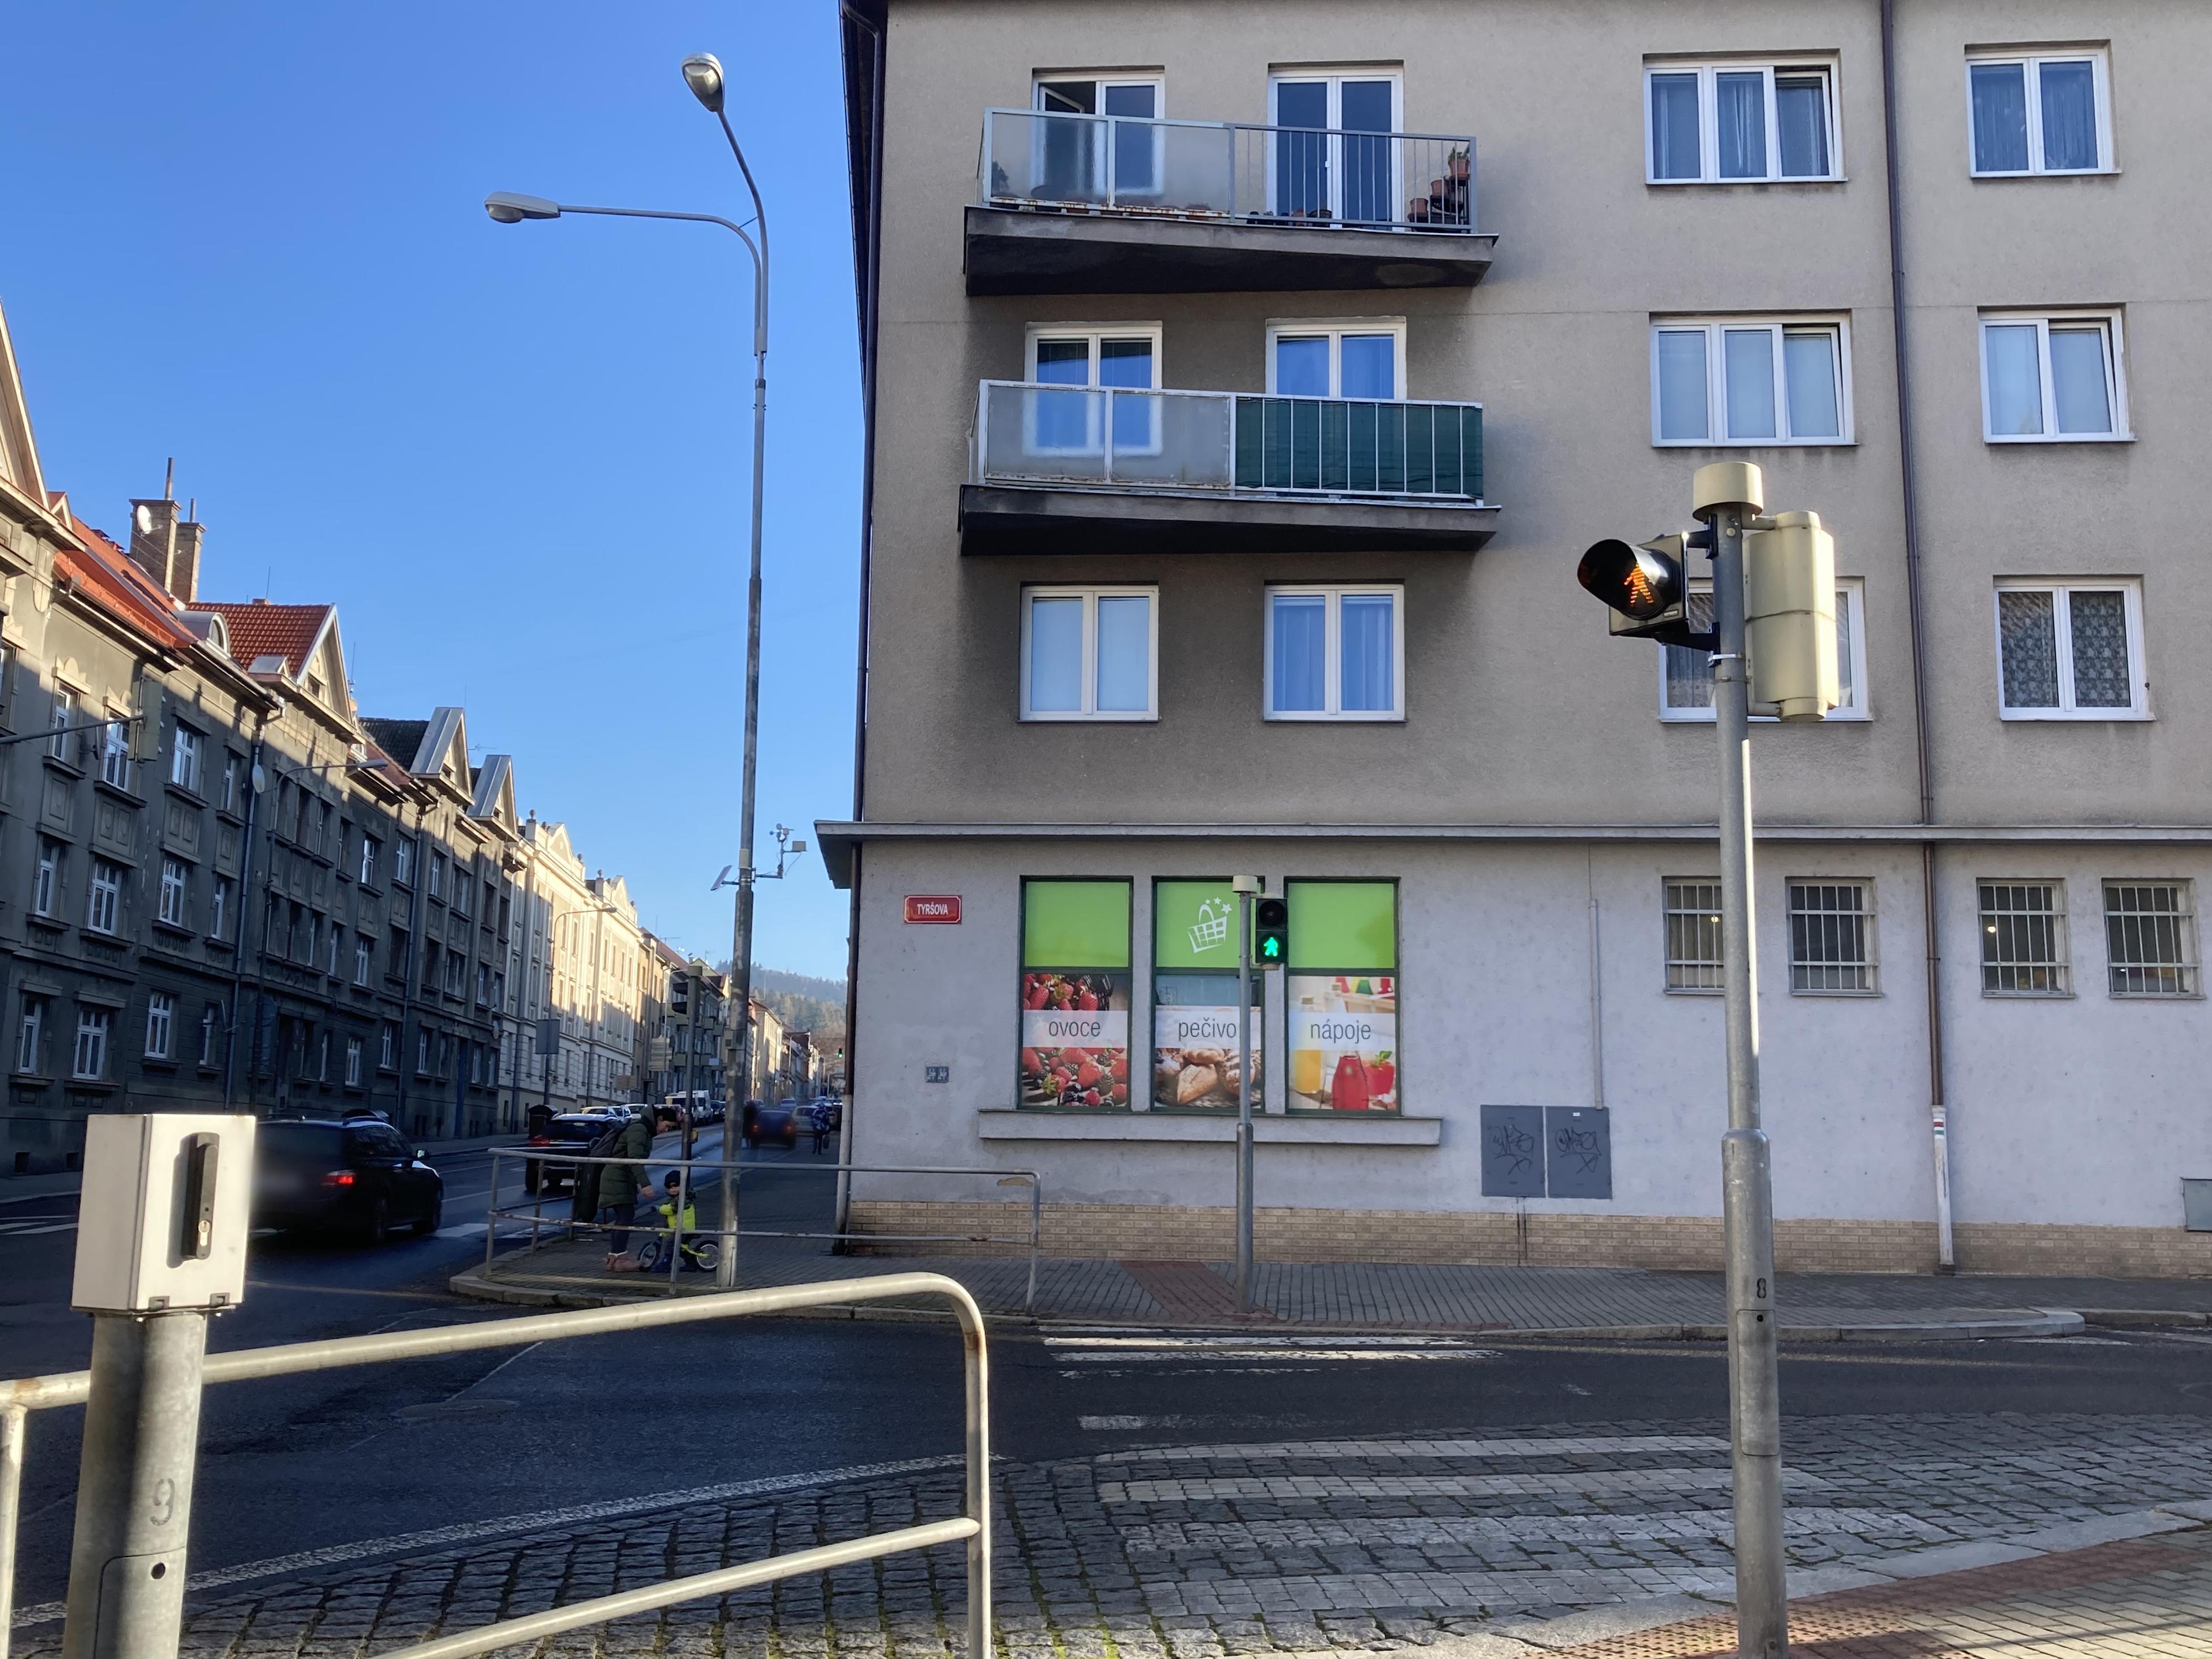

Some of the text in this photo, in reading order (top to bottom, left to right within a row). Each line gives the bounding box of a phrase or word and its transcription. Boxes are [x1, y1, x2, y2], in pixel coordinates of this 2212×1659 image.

[917, 902, 948, 915] TYRŠOVA
[1048, 1021, 1100, 1037] ovoce
[1178, 1017, 1237, 1042] pečivo
[1311, 1019, 1371, 1044] nápoje
[1757, 1277, 1767, 1299] 8
[150, 1478, 175, 1526] 9
